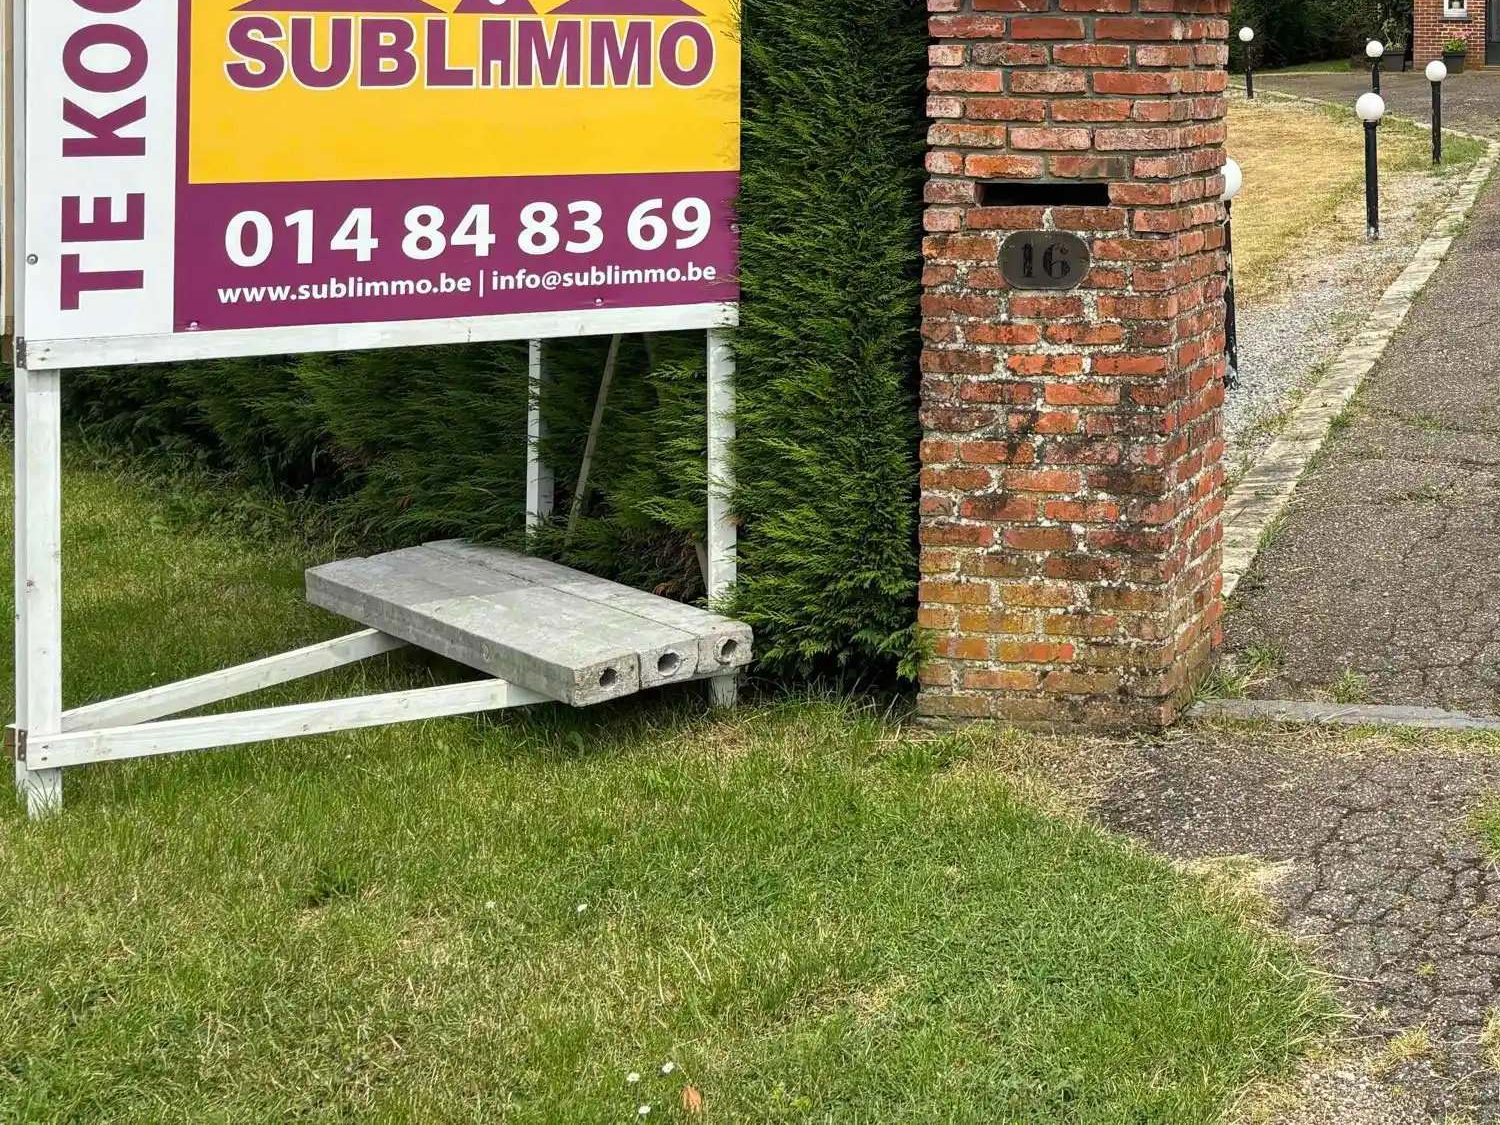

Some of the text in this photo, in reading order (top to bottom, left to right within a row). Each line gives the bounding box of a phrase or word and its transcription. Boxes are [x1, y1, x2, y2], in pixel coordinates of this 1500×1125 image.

[225, 17, 715, 89] SUBLIMMO
[60, 192, 146, 311] TE
[225, 196, 712, 267] 014 84 83 69
[1020, 242, 1071, 280] 16
[216, 273, 472, 304] www.sublimmo.be
[491, 261, 717, 291] info@sublimmo.be
